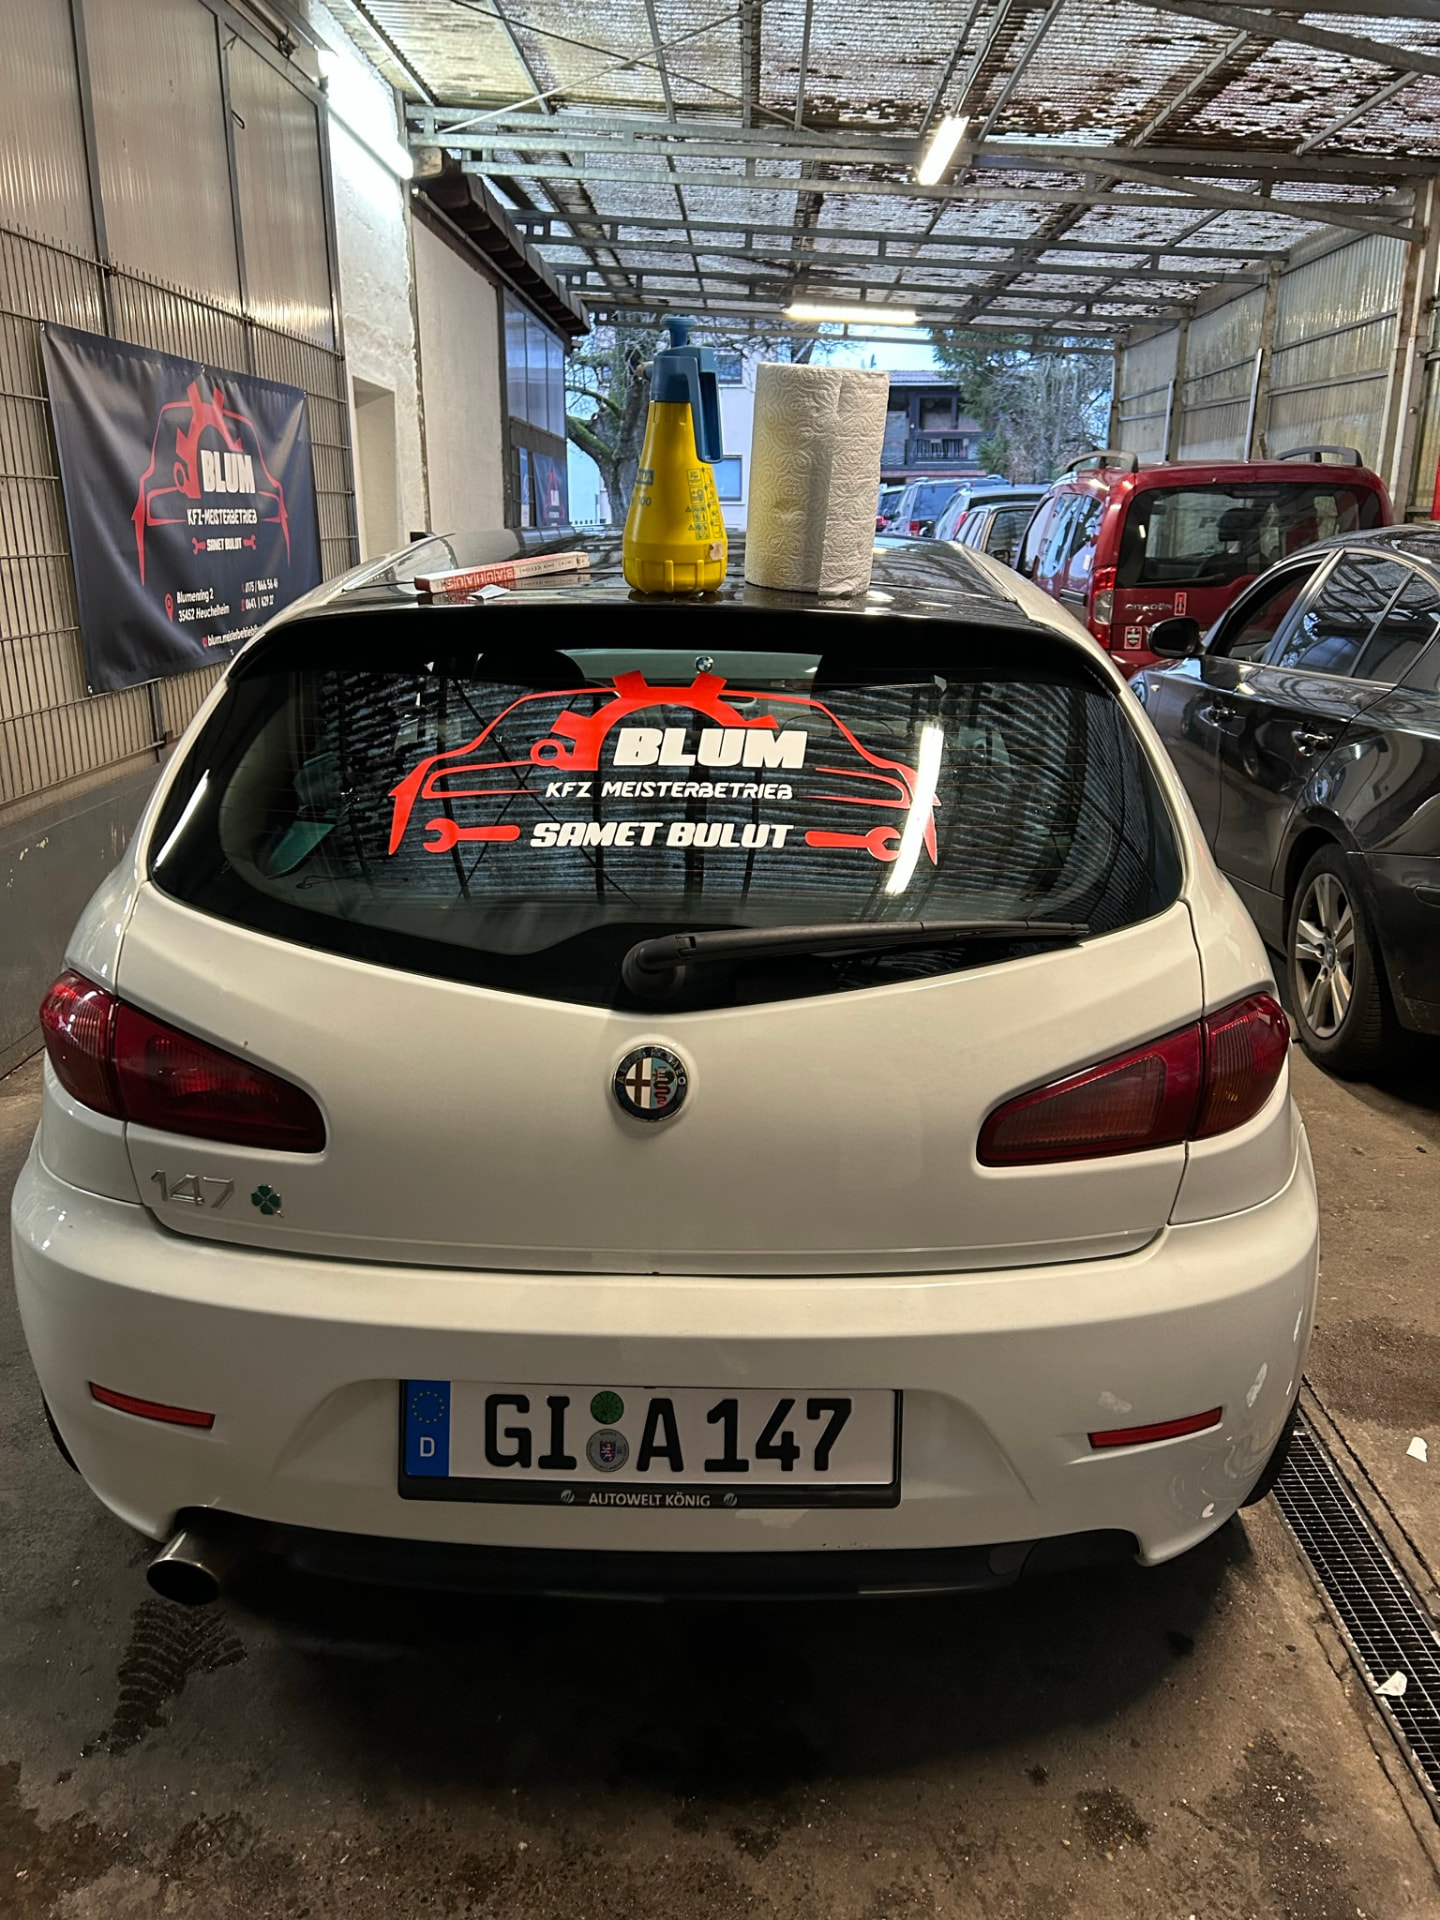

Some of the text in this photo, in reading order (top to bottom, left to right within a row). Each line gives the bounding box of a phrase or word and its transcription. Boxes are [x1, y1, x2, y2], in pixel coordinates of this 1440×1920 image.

[200, 450, 255, 493] BLUM
[187, 508, 257, 525] KFZ-MEISTERBETRIEB
[445, 567, 514, 589] BAUHAUS
[177, 587, 214, 603] Blumenring 2
[613, 728, 808, 768] BLUM
[545, 781, 793, 799] KFZ MEISTERBETRIEB
[530, 822, 794, 848] SAMET BULUT
[151, 1169, 235, 1209] 147
[484, 1394, 852, 1472] GI A 147
[419, 1437, 435, 1458] D
[589, 1491, 711, 1507] AUTOWELT KÖNIG
